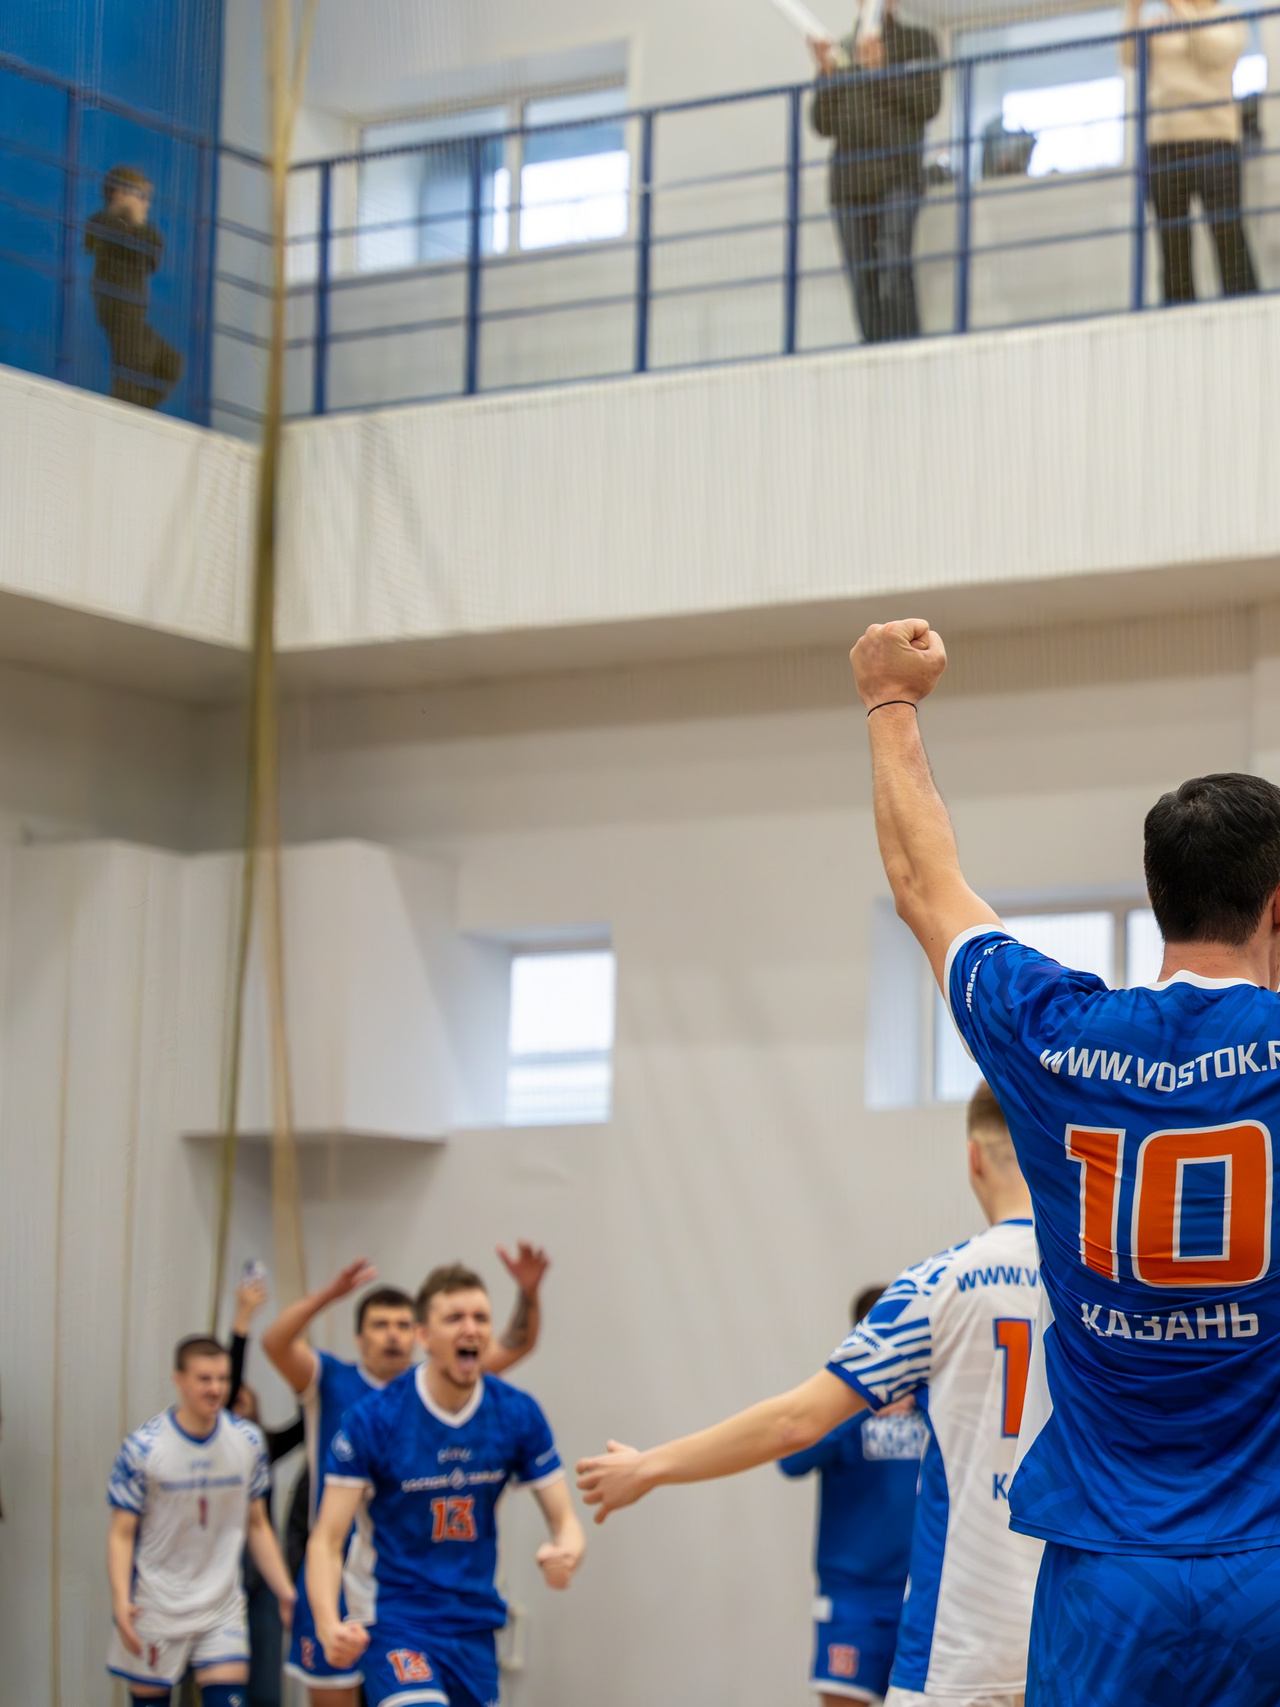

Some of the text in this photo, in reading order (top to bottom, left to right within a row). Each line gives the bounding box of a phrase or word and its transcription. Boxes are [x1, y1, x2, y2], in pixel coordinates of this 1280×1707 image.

[1065, 1119, 1273, 1288] 10
[957, 1266, 1043, 1292] WWW.V
[1081, 1302, 1259, 1341] КАЗАНЬ
[993, 1318, 1036, 1438] 1
[431, 1494, 477, 1542] 13
[387, 1650, 433, 1683] 13
